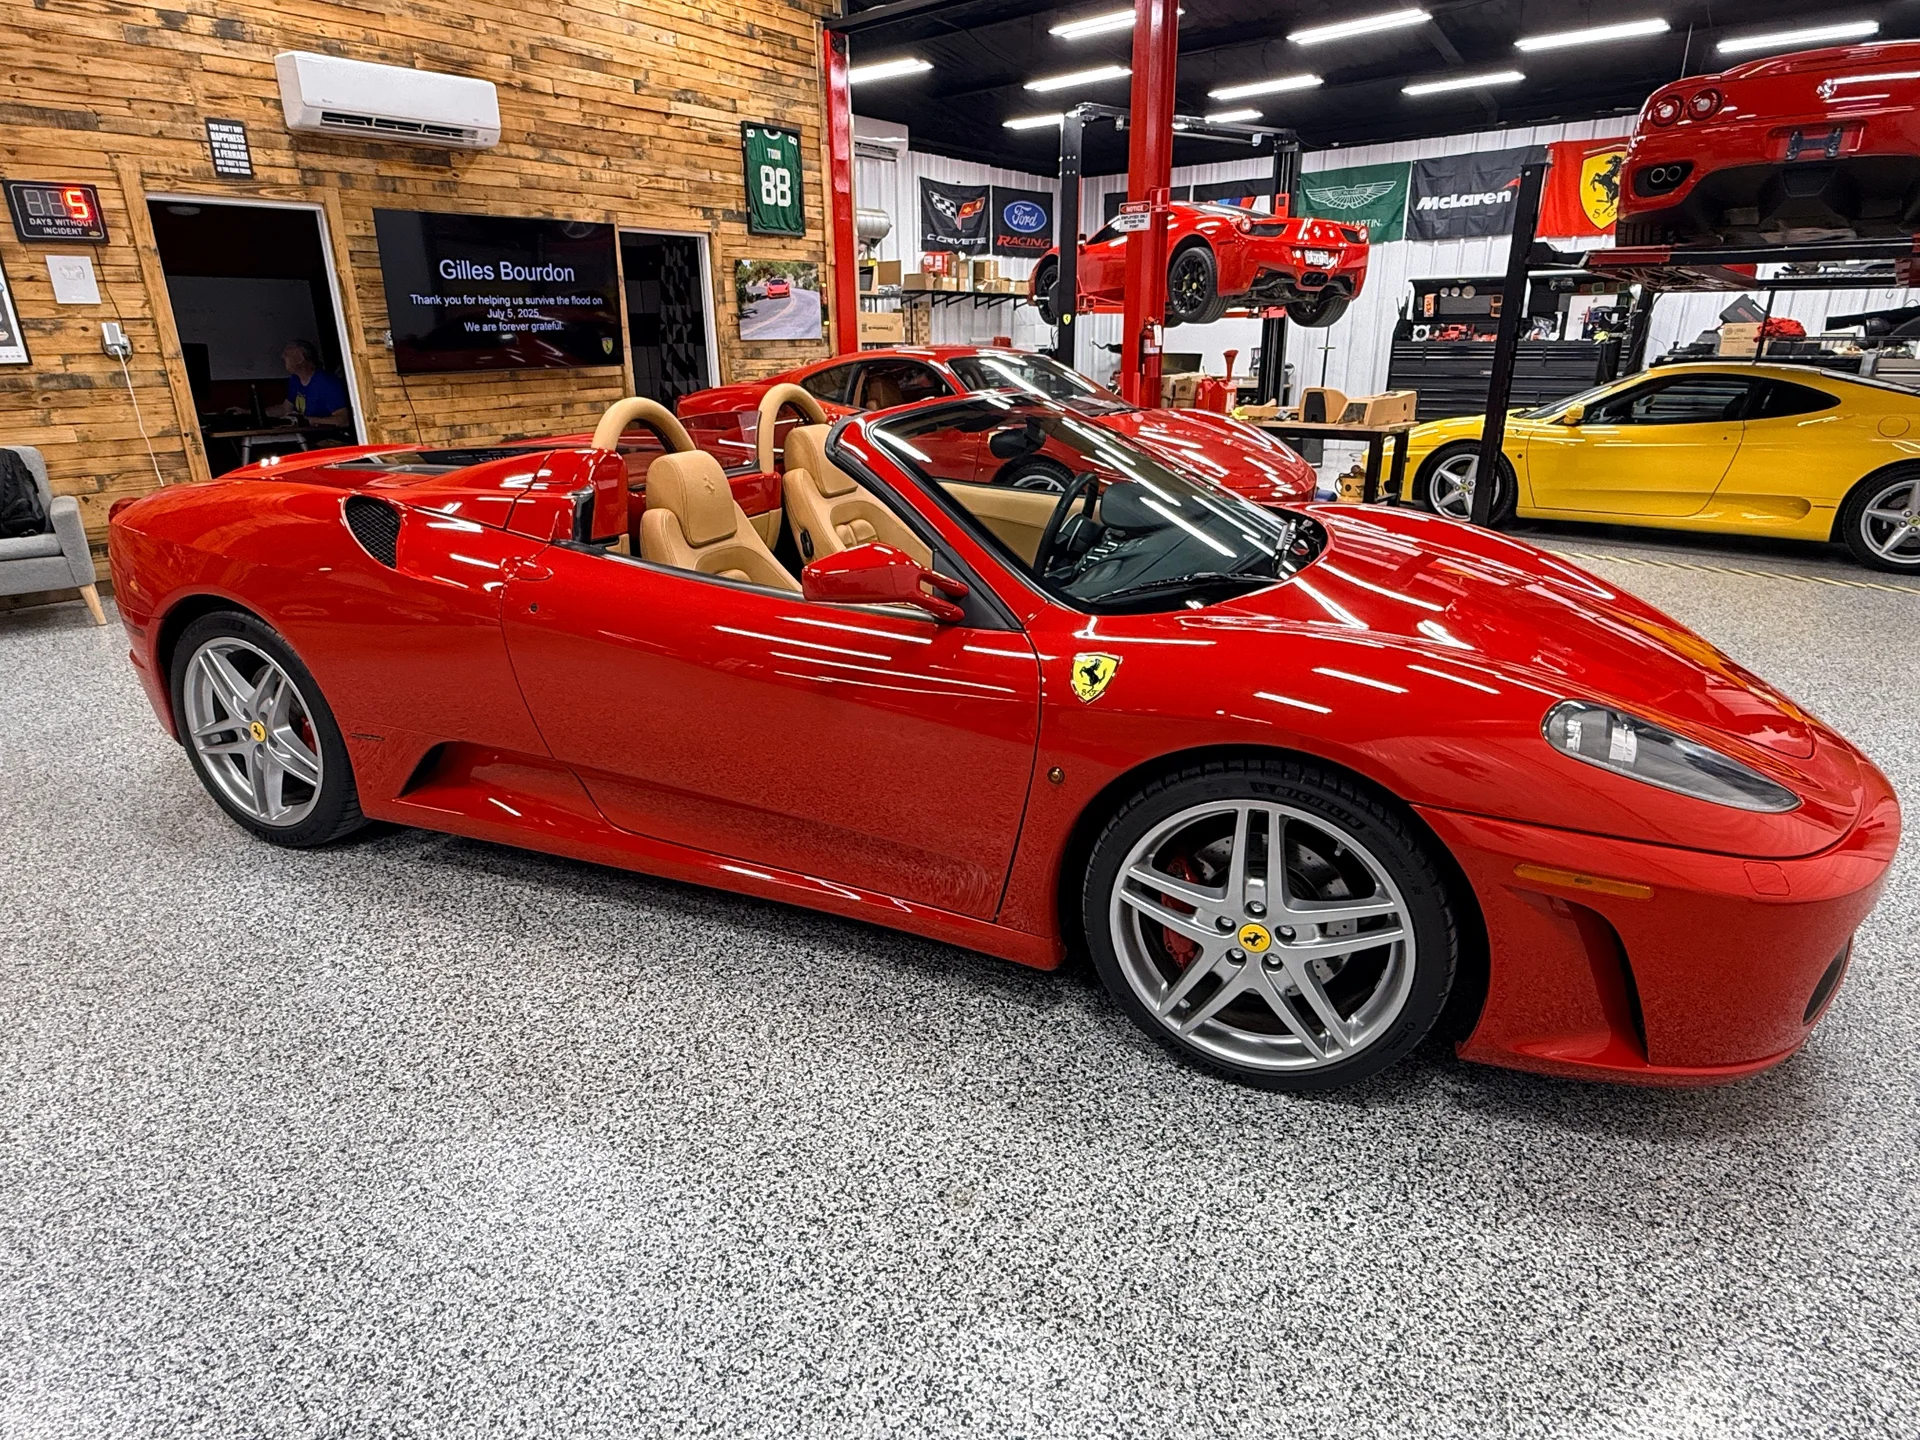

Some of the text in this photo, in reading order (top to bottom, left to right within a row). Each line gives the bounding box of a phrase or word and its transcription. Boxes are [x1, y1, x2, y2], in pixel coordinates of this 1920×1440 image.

[760, 165, 791, 207] 88
[66, 190, 89, 219] 5
[1416, 190, 1512, 211] McLaren
[1126, 204, 1143, 212] NOTICE
[1012, 204, 1038, 227] Ford
[29, 218, 93, 227] DAYS WITHOUT
[43, 227, 83, 235] INCIDENT
[926, 234, 987, 245] CORVETTE
[996, 235, 1051, 249] RACING
[439, 259, 575, 282] Gilles Bourdon
[410, 294, 603, 307] Thank you for helping us survive the flood on
[487, 309, 542, 320] July 5, 2025.
[464, 321, 564, 333] We are forever grateful.
[1274, 786, 1362, 828] MICHELIN
